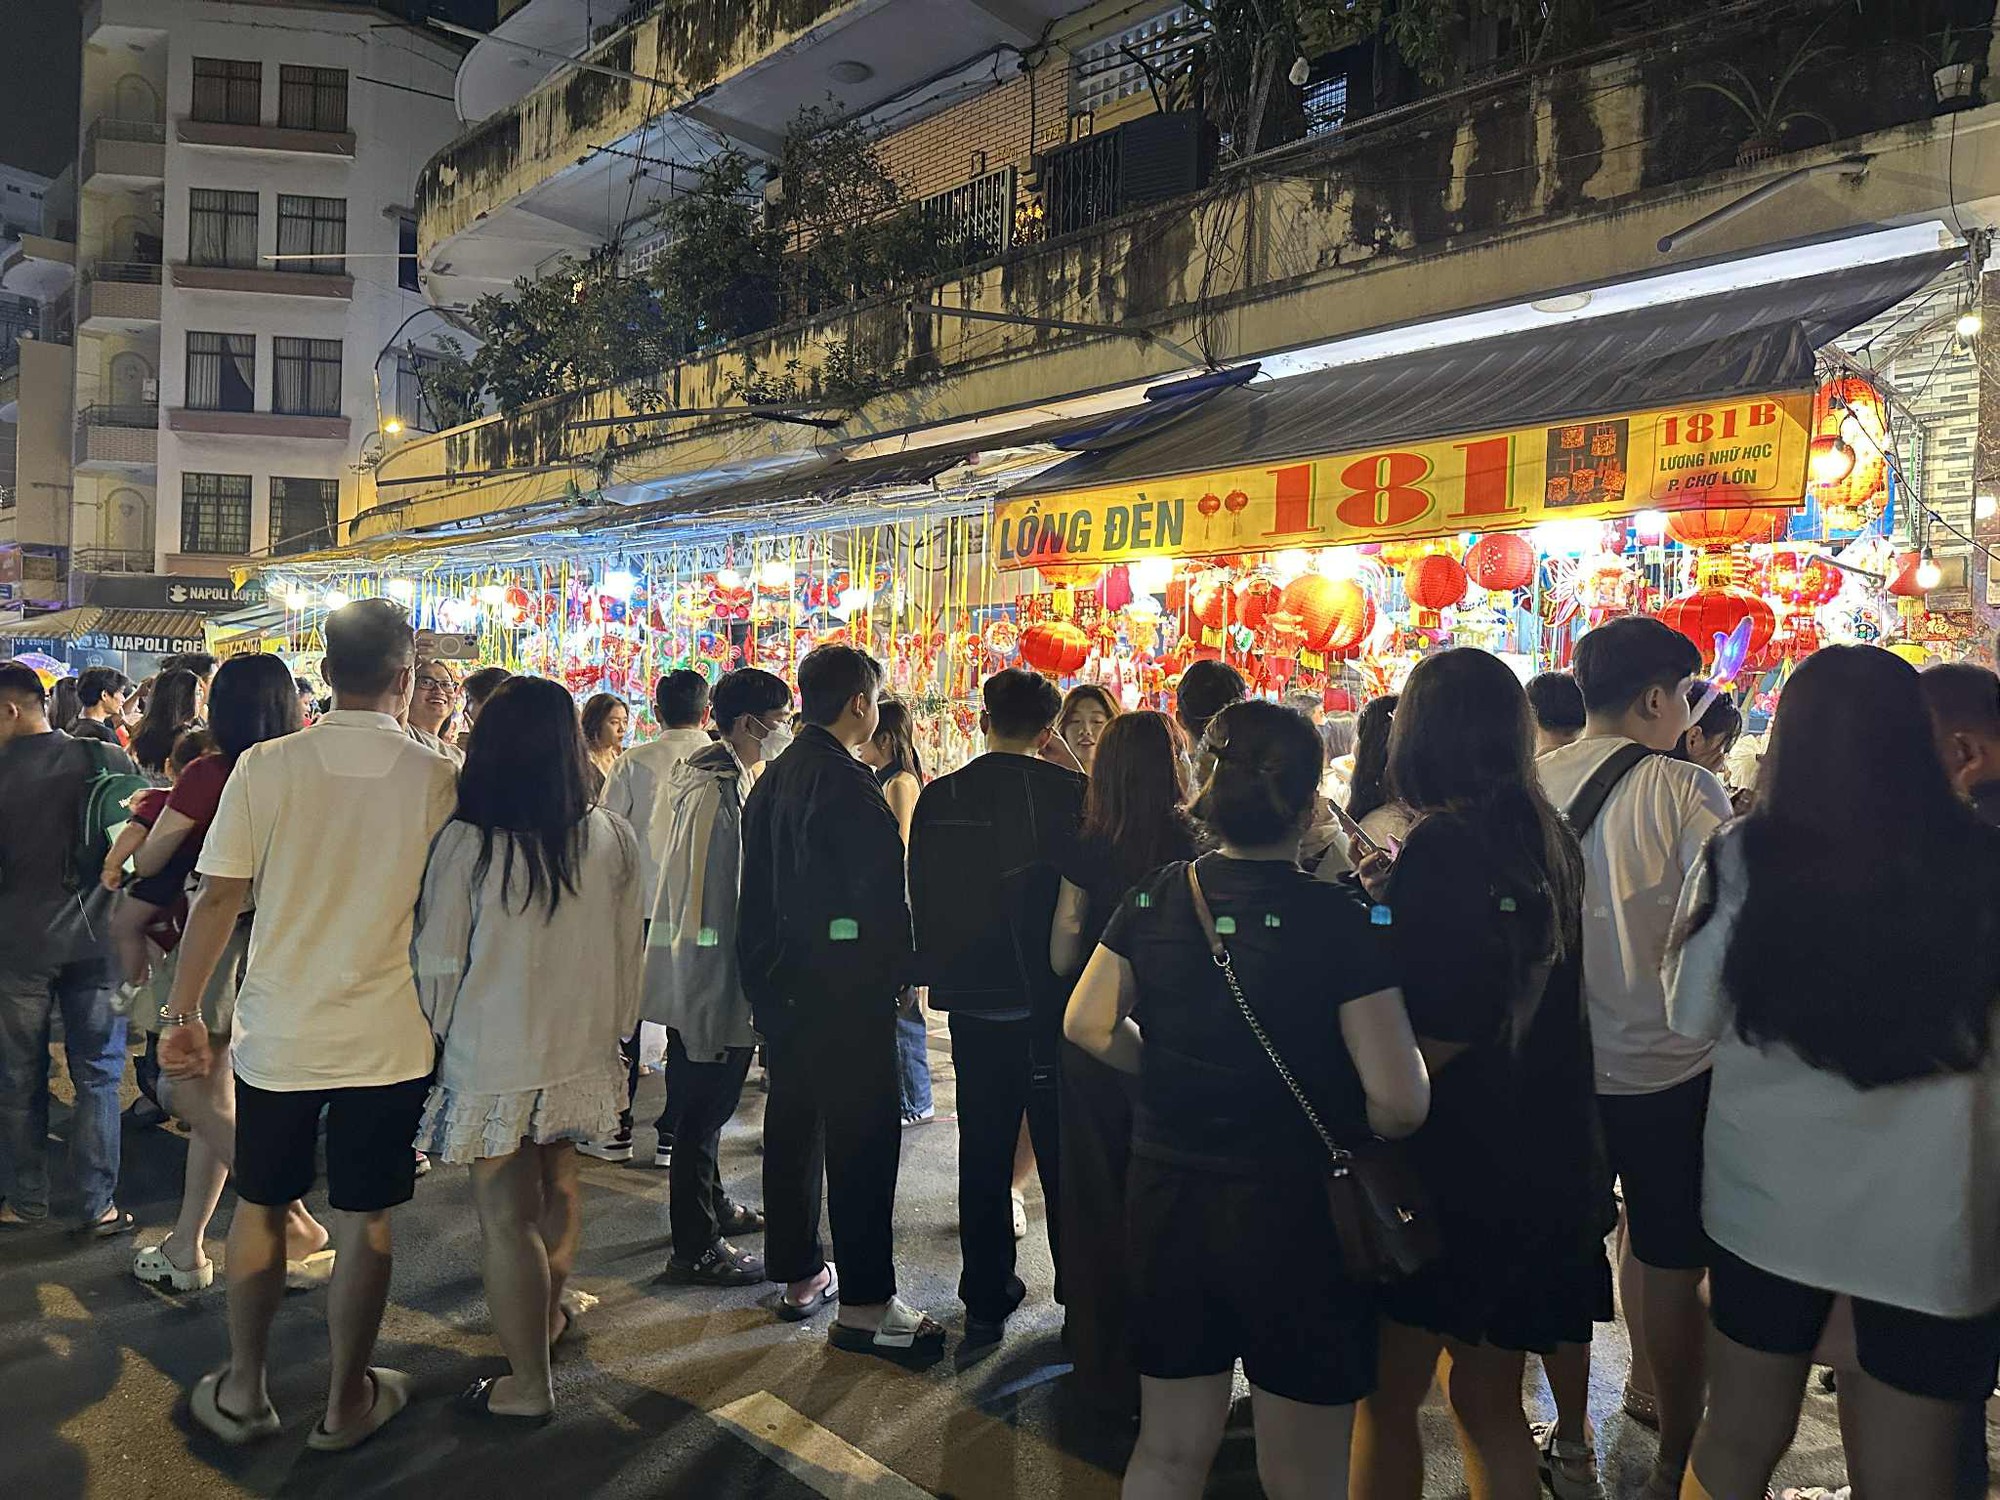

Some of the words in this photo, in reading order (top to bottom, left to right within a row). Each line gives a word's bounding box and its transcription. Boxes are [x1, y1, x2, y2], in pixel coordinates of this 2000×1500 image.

[1660, 452, 1704, 471] LƯƠNG
[1709, 446, 1741, 465] NHỮ
[1742, 443, 1772, 461] HỌC
[1261, 435, 1527, 537] 181
[1668, 479, 1679, 491] P.
[1684, 471, 1718, 489] CHỢ
[1722, 466, 1757, 484] LỚN
[1000, 500, 1092, 560] LỒNG
[1103, 493, 1184, 551] ĐÈN
[190, 587, 228, 600] NAPOLI
[112, 636, 168, 652] NAPOLI
